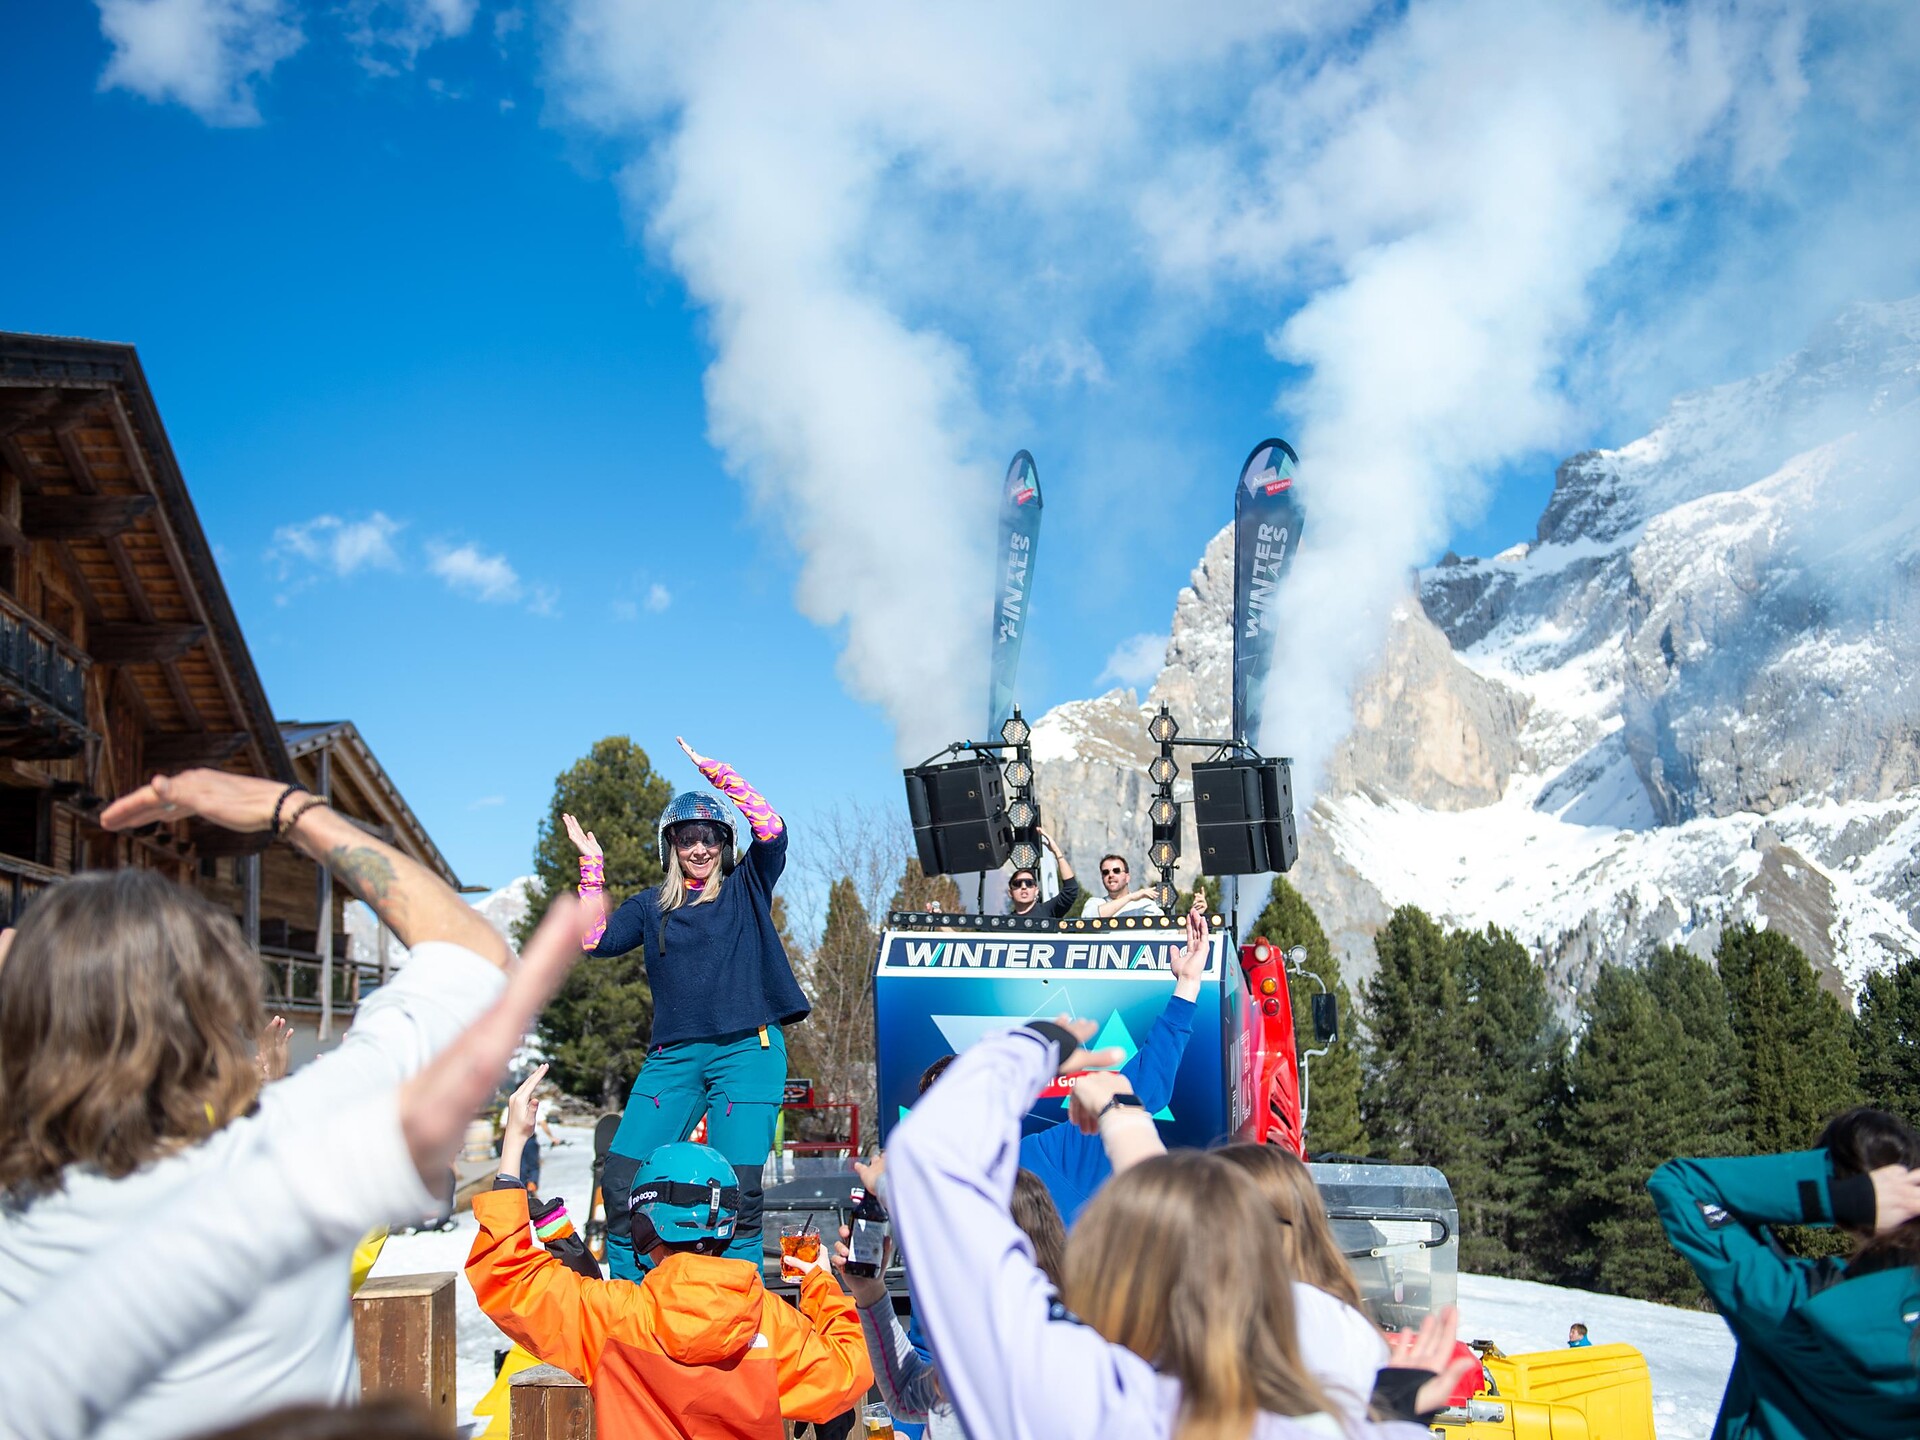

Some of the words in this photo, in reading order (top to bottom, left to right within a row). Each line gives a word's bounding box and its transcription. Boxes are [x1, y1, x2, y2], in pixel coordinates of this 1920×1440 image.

[999, 532, 1021, 644] WINTER
[1007, 536, 1030, 638] FINALS
[1245, 523, 1274, 638] WINTER
[905, 942, 1055, 969] WINTER
[1065, 944, 1188, 969] FINAL
